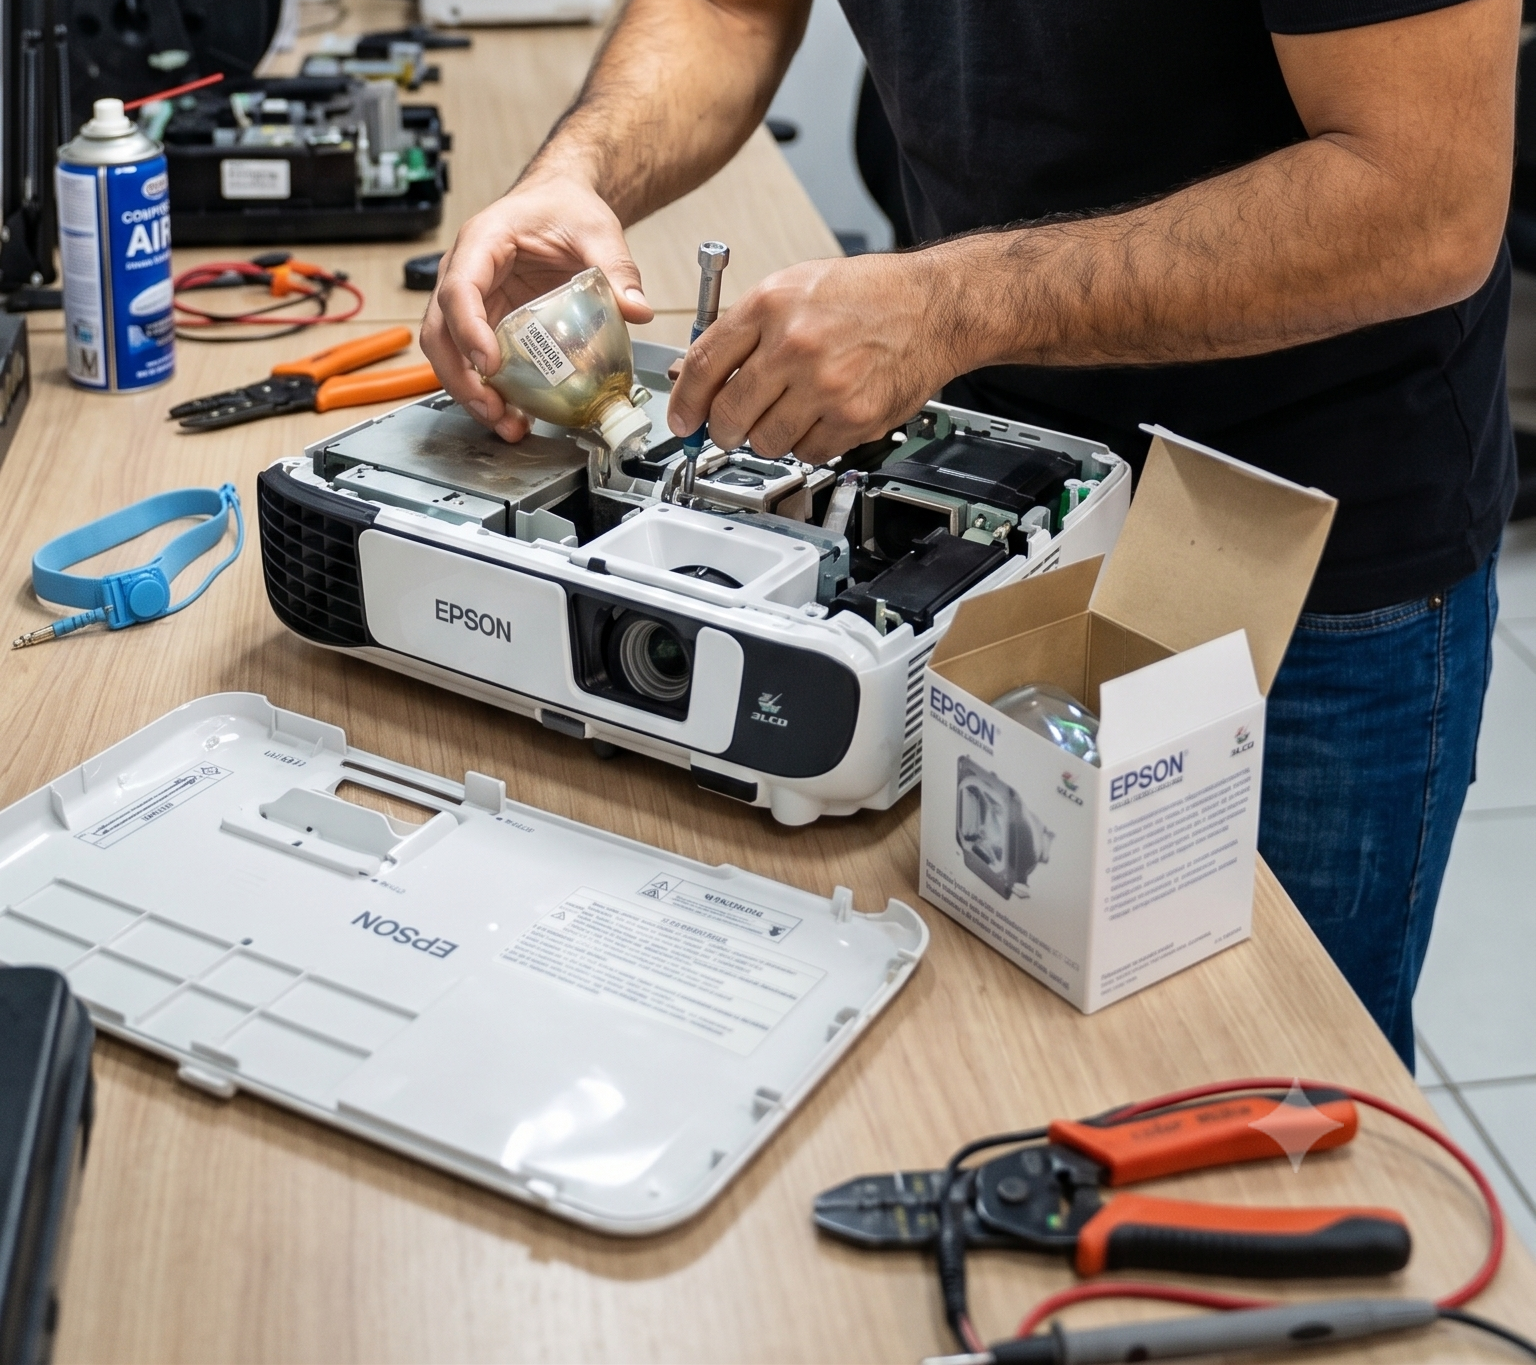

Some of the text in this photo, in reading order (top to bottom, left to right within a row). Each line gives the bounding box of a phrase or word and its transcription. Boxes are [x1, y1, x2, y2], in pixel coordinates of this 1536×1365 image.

[126, 215, 171, 258] AIR
[435, 598, 511, 643] EPSON
[750, 711, 789, 727] 3LCD
[930, 685, 995, 747] EPSON
[1110, 750, 1184, 802] EPSON
[351, 910, 460, 959] EPSON
